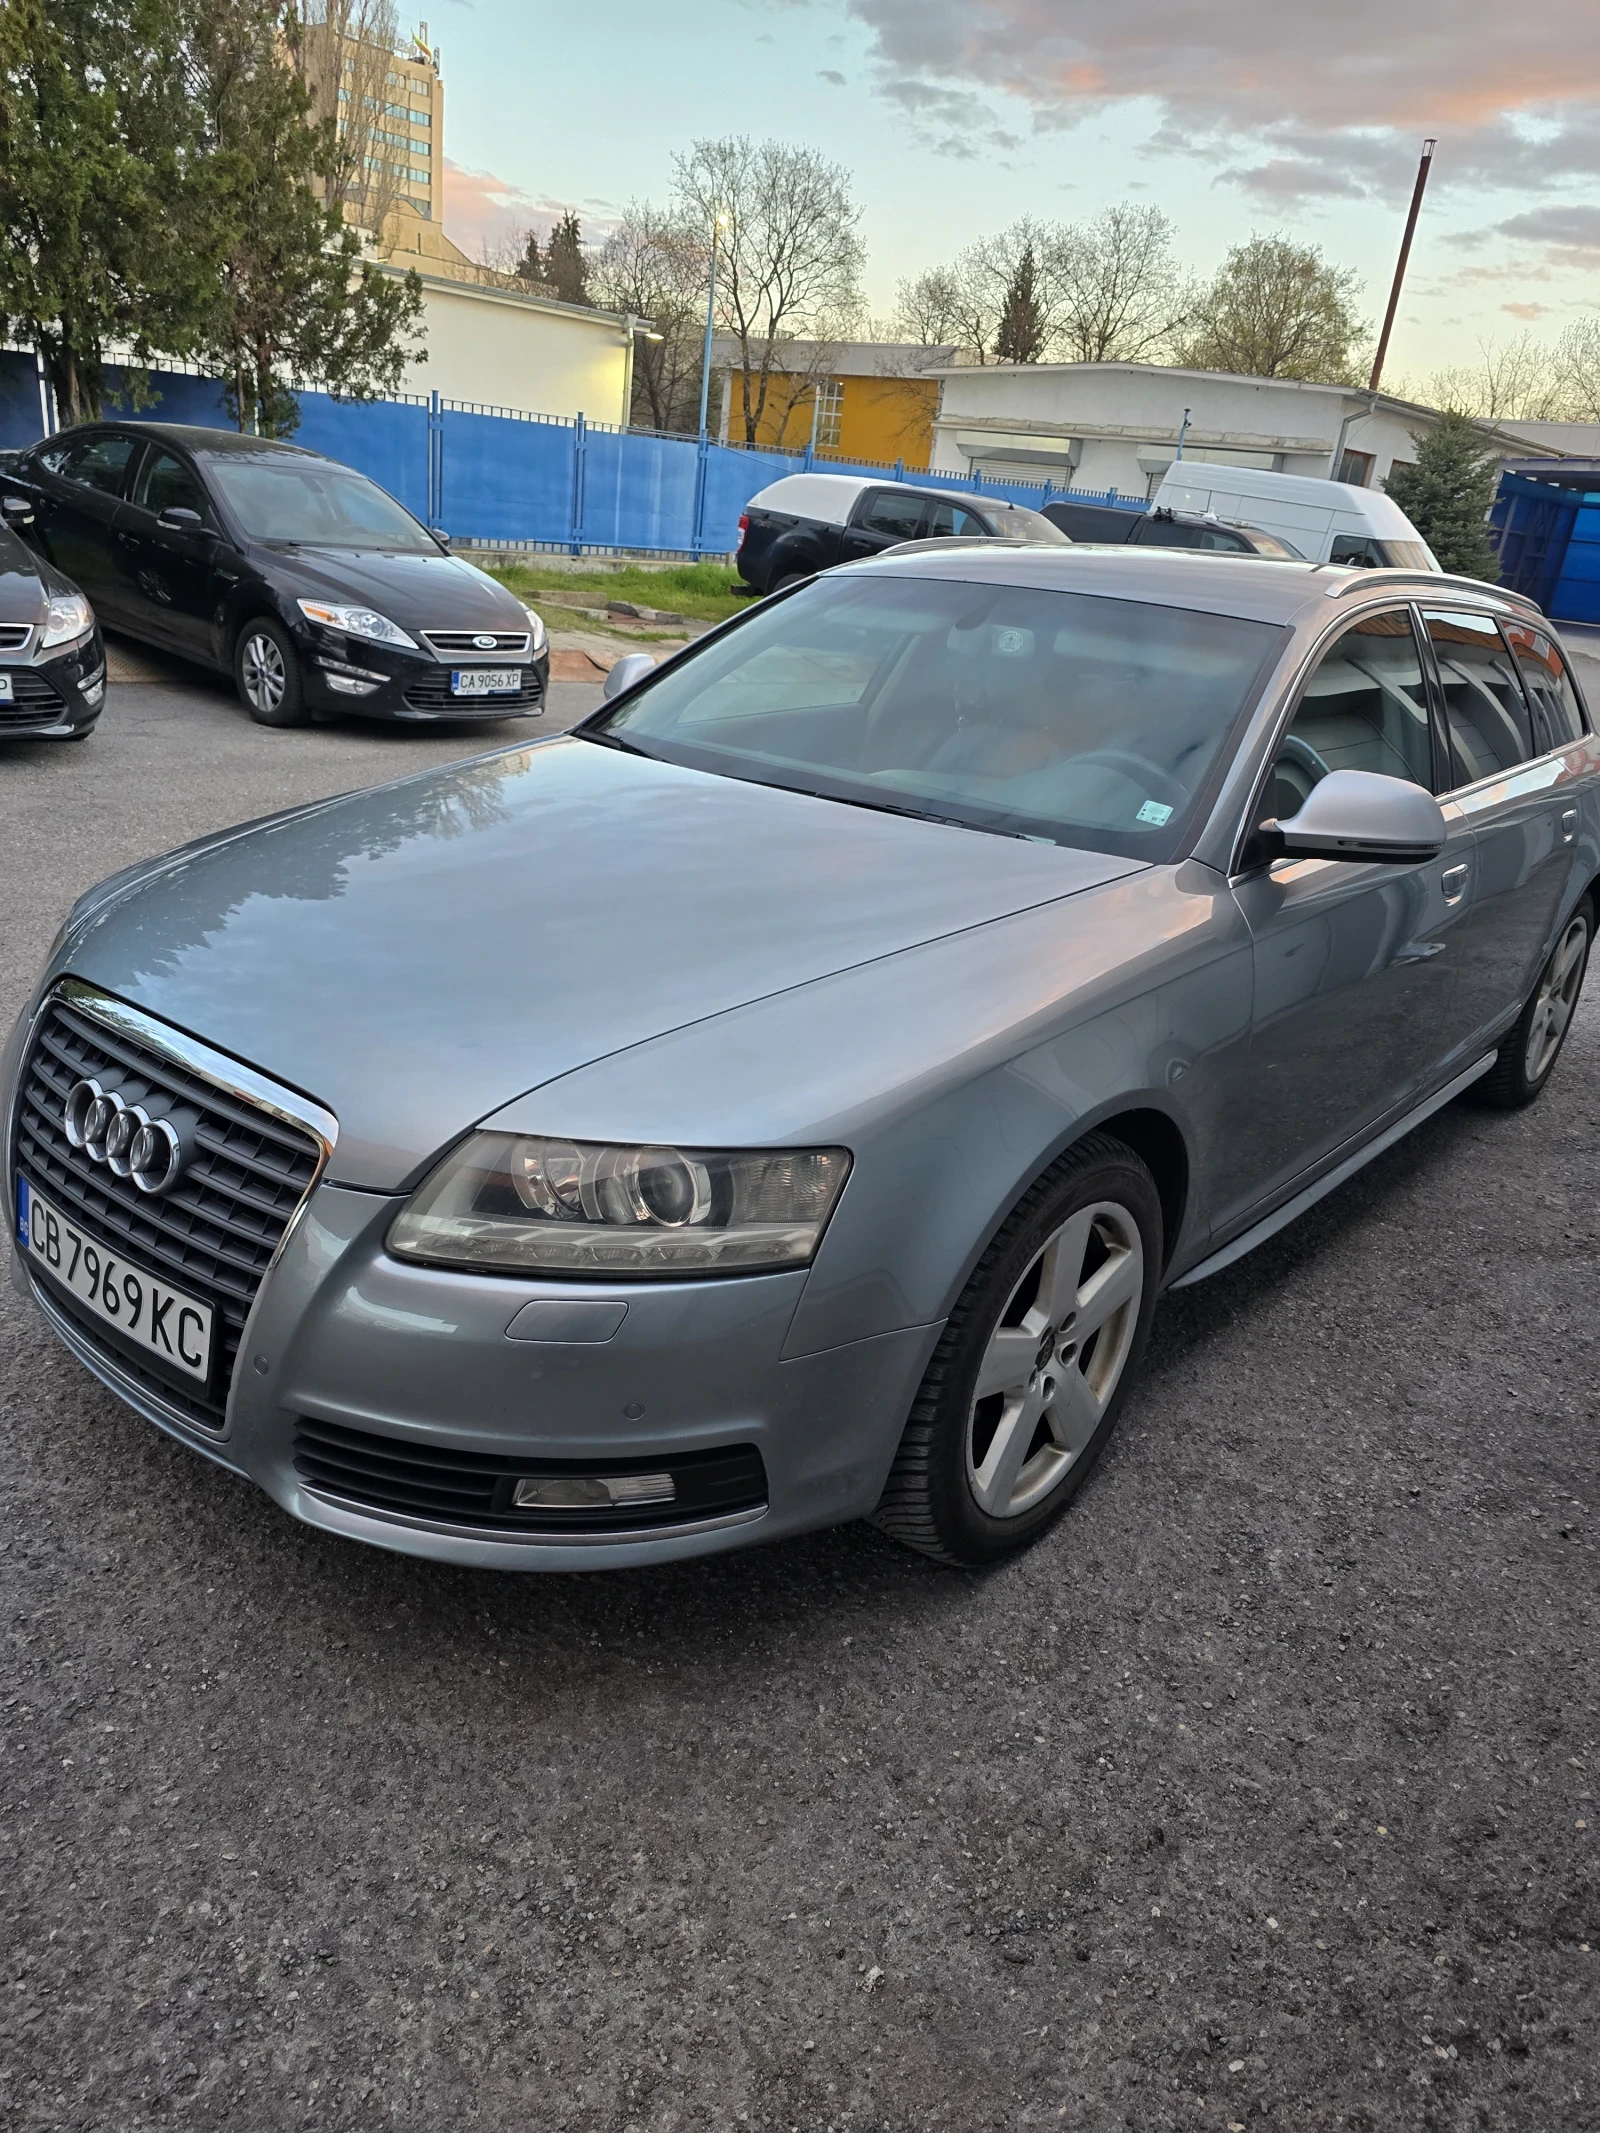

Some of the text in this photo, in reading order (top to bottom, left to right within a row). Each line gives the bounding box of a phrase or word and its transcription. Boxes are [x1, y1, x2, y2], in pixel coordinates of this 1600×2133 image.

[461, 674, 475, 689] CA
[478, 674, 504, 688] 9056
[506, 673, 519, 688] XP
[20, 1216, 29, 1237] BG
[31, 1198, 204, 1368] CB 7969 KC
